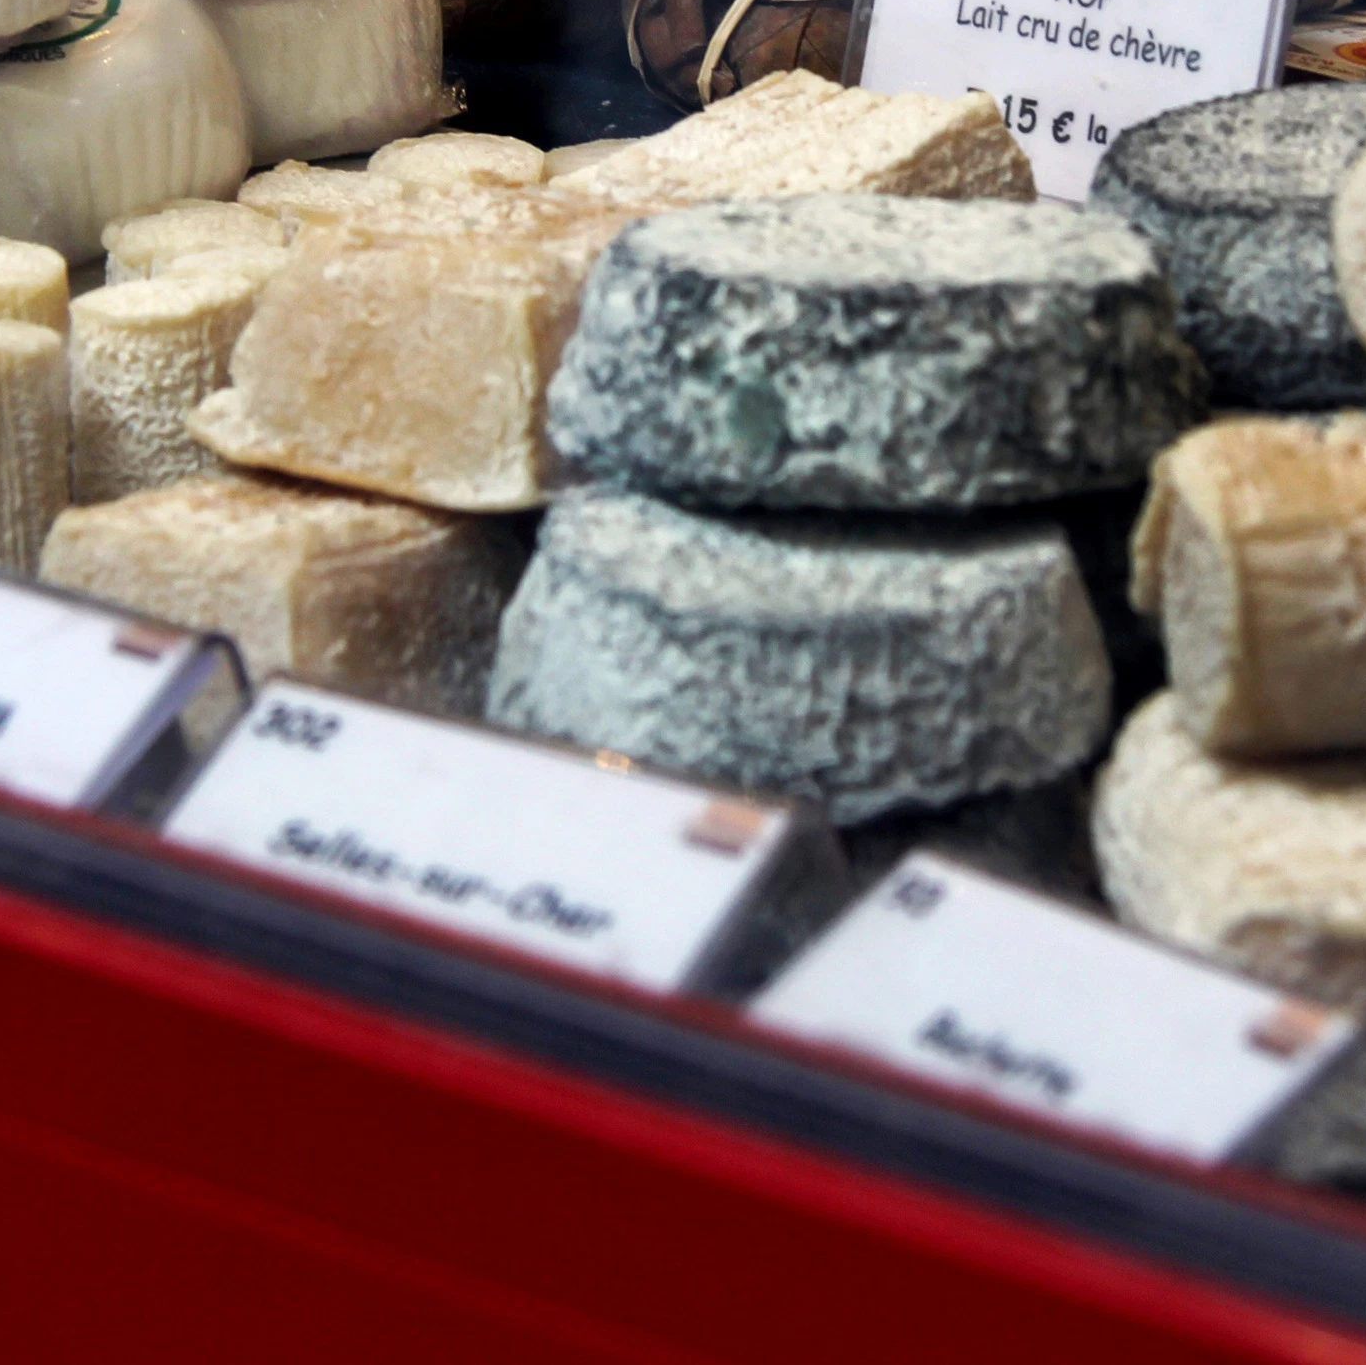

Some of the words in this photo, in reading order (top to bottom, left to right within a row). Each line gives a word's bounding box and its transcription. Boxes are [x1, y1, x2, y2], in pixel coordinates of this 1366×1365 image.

[1016, 13, 1060, 43] cru
[1069, 18, 1101, 53] de
[1109, 27, 1202, 73] chèvre
[1052, 111, 1075, 144] €
[1087, 113, 1108, 145] la
